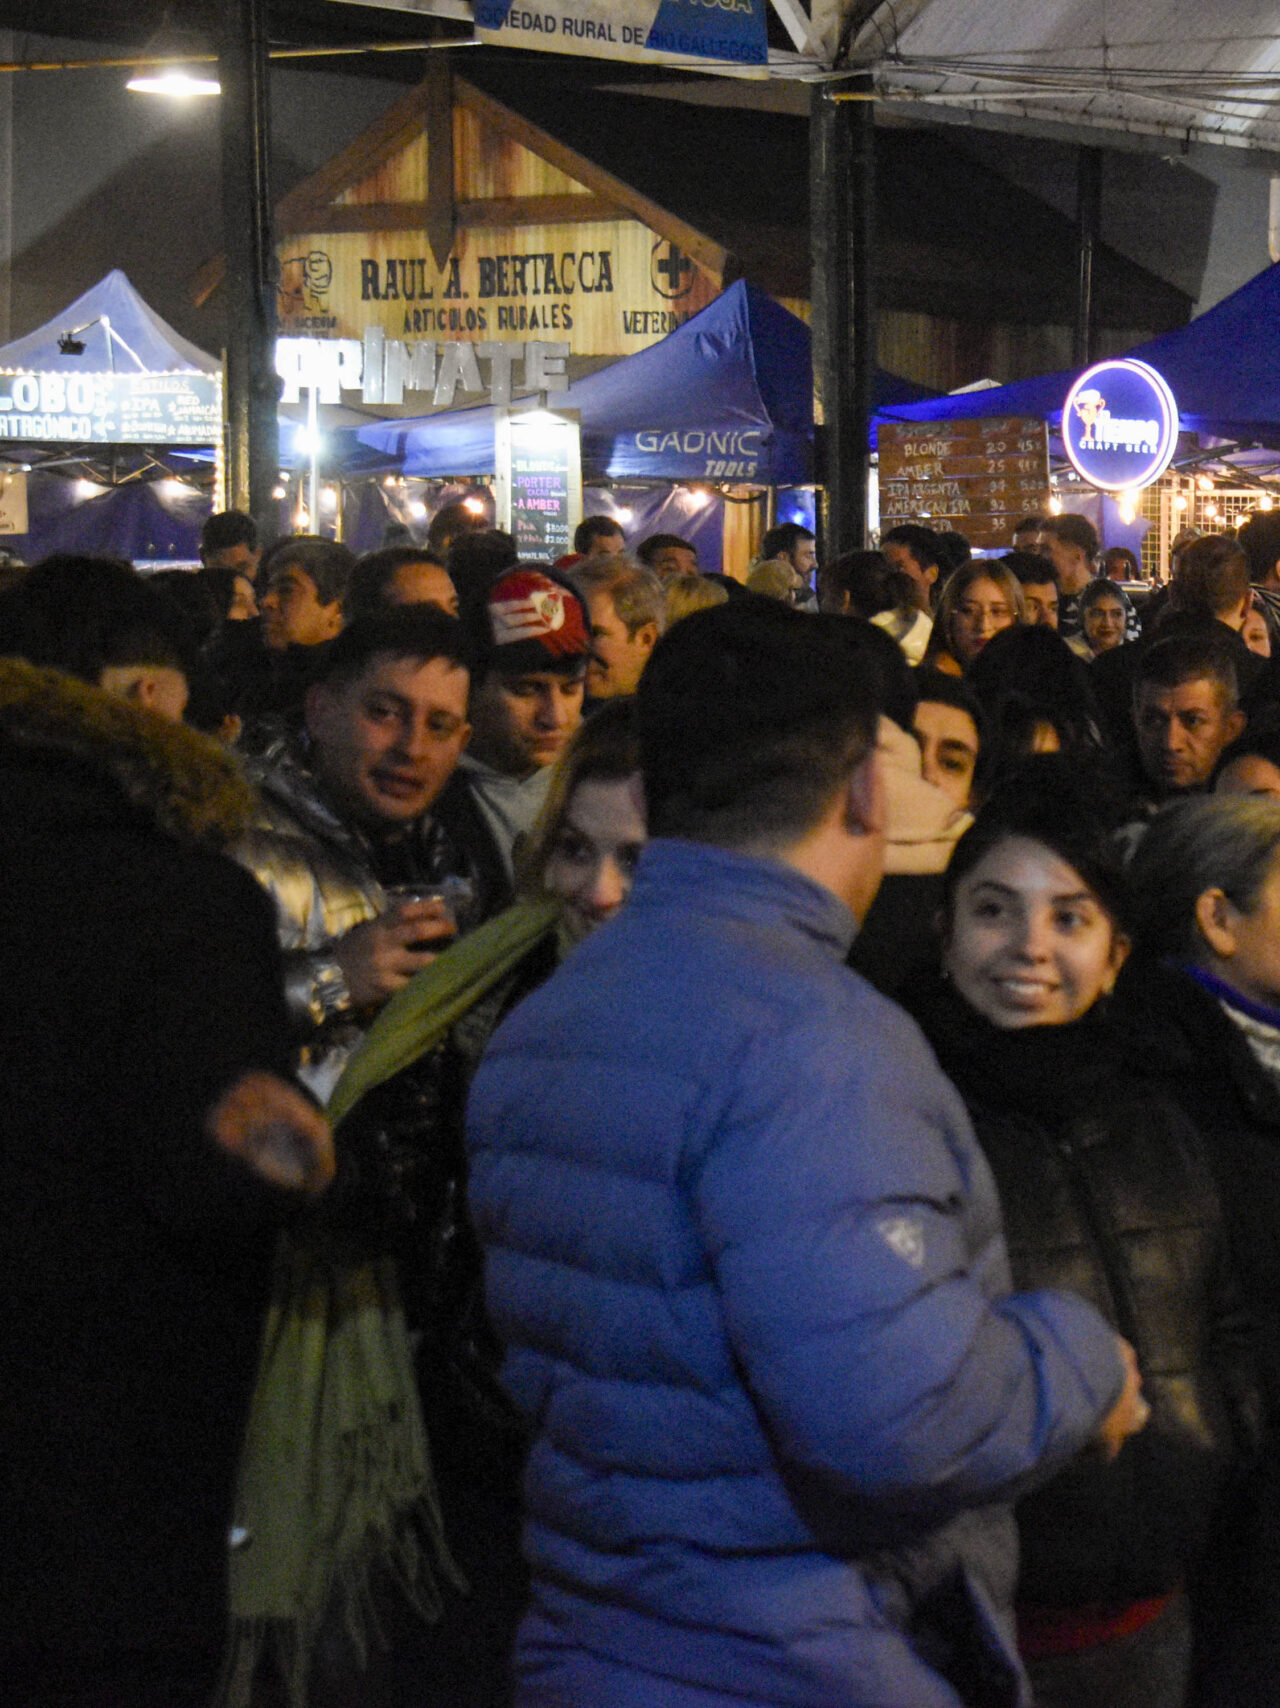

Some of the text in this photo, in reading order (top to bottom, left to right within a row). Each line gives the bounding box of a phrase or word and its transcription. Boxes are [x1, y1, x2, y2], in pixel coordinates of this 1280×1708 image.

[562, 18, 617, 42] RURAL
[622, 26, 644, 46] DE
[361, 259, 434, 300] RAUL
[477, 251, 614, 299] BERTACCA
[500, 303, 573, 331] RURALES
[904, 441, 952, 457] BLONDE
[1079, 440, 1158, 454] CRAFT BEER
[704, 460, 758, 477] TOOLS
[898, 463, 944, 477] AMBER
[517, 476, 561, 488] PORTER
[527, 498, 560, 510] AMBER
